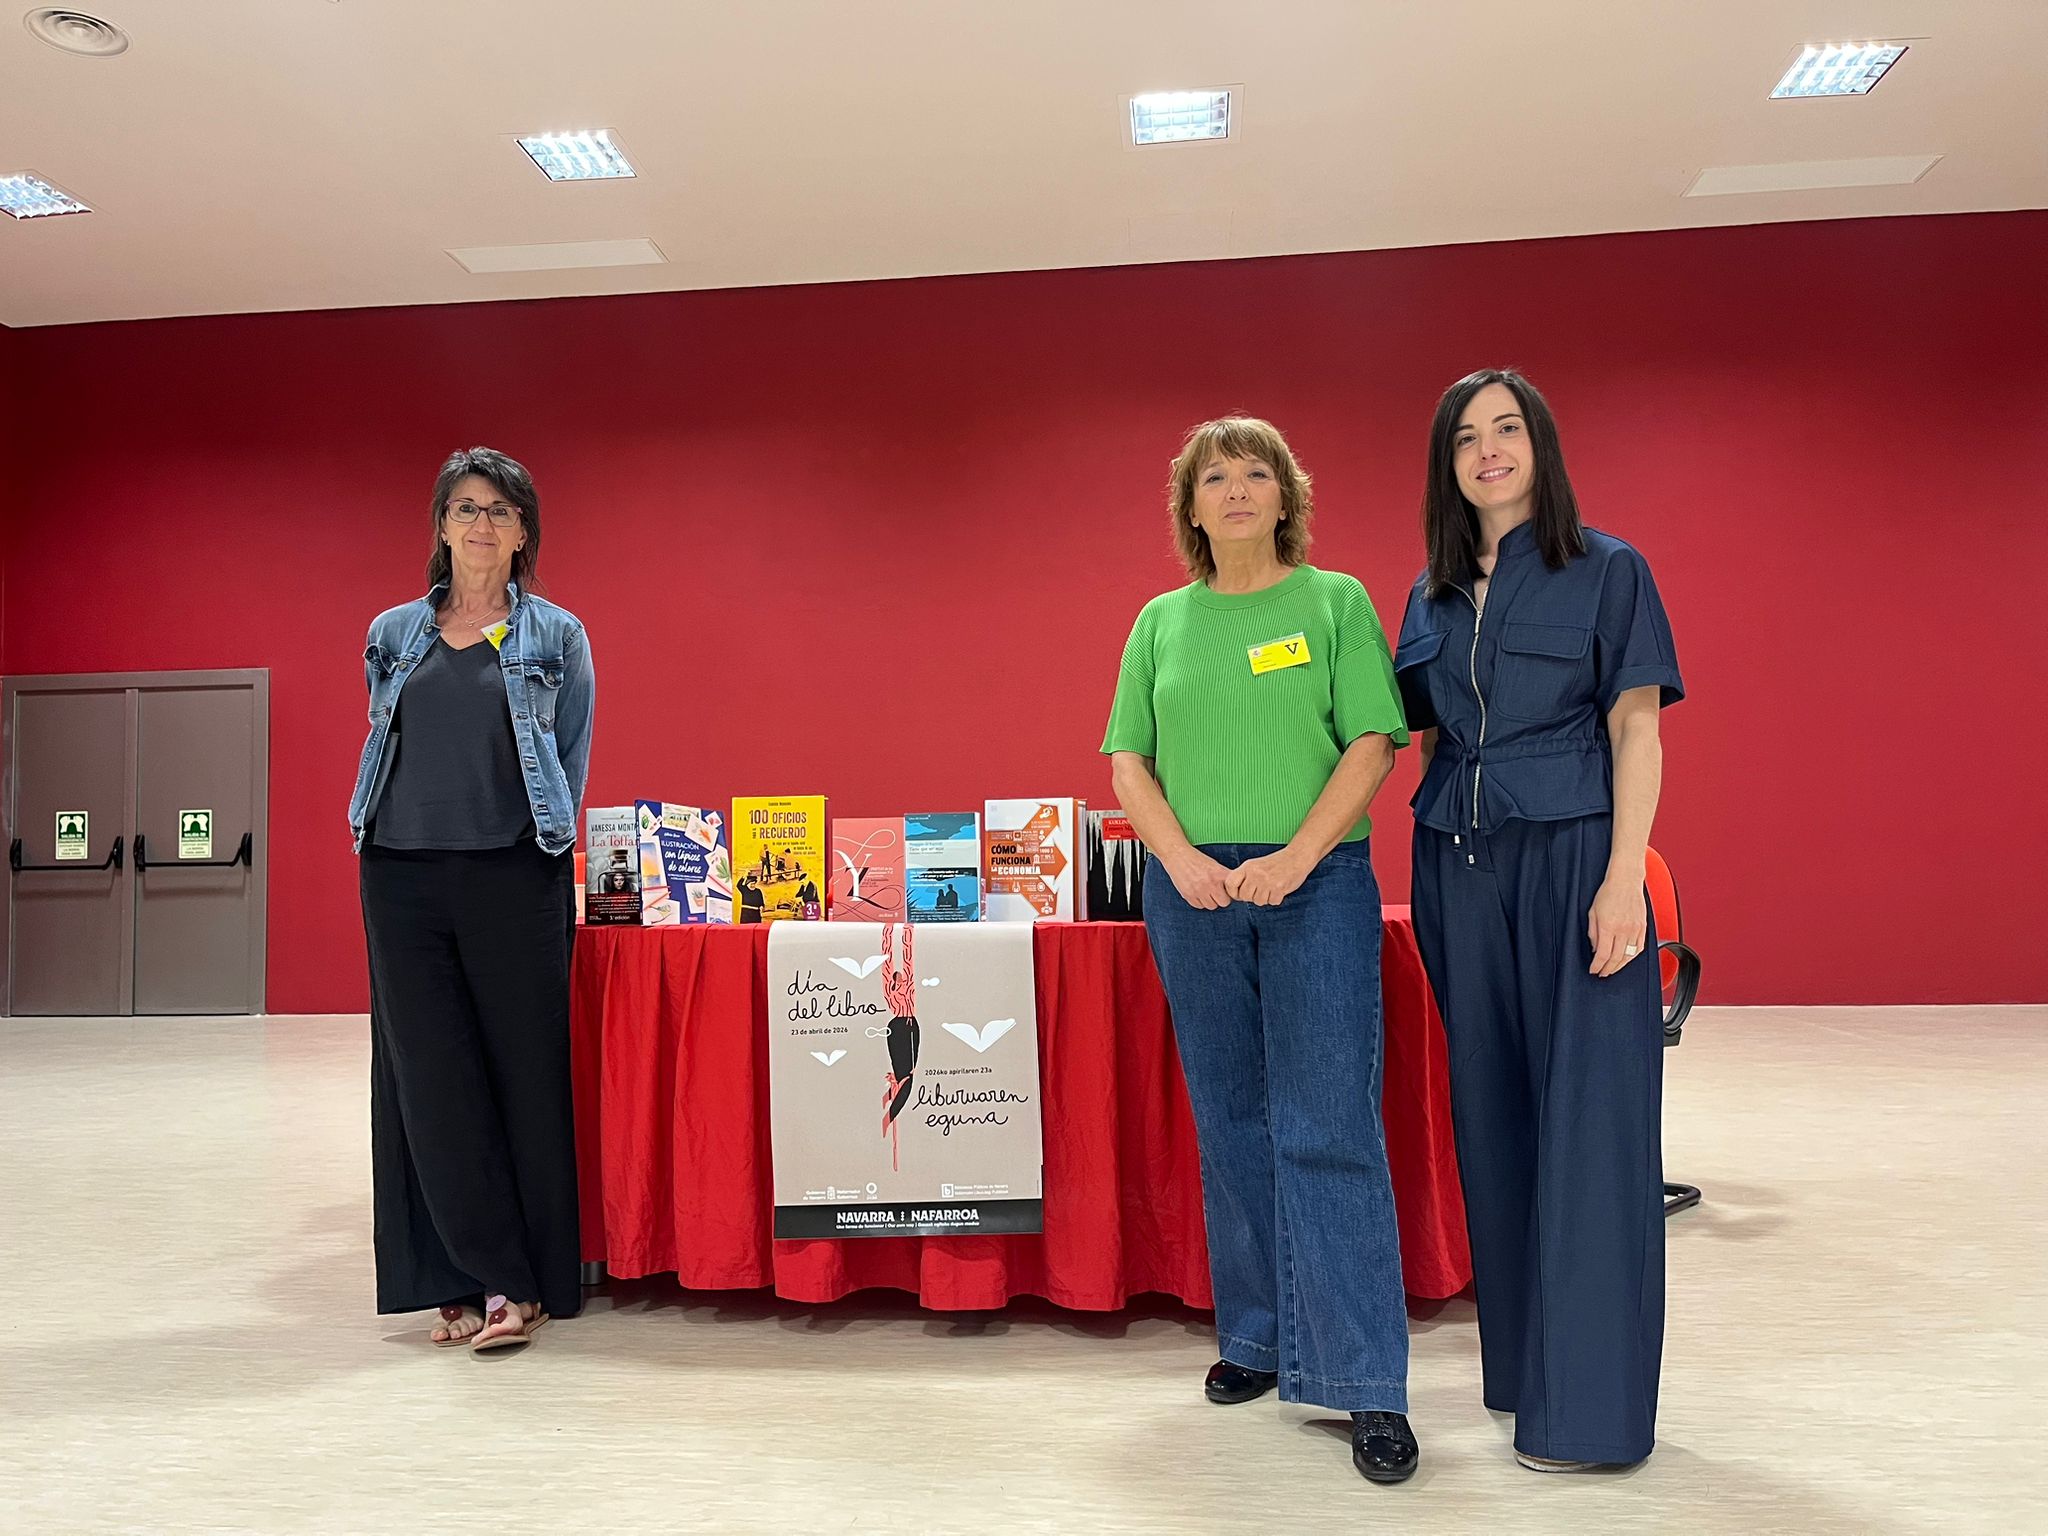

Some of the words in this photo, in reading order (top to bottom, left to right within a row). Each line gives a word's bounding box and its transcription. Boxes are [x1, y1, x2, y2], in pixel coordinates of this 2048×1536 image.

[1284, 642, 1299, 655] V
[749, 809, 769, 824] 100
[772, 812, 807, 824] OFICIOS
[591, 823, 615, 832] VANESSA
[760, 826, 806, 839] RECUERDO
[607, 834, 637, 847] Toffa
[991, 843, 1017, 855] CÓMO
[668, 861, 677, 871] de
[678, 862, 701, 873] colores
[991, 857, 1031, 865] FUNCIONA
[998, 864, 1041, 875] ECONOMÍA
[787, 970, 838, 996] día
[788, 997, 823, 1021] del
[826, 990, 886, 1018] libro
[949, 1068, 979, 1076] apirilaren
[912, 1083, 1028, 1110] liburuaren
[925, 1111, 1008, 1136] eguna
[836, 1211, 895, 1223] NAVARRA
[911, 1208, 979, 1221] NAFARROA
